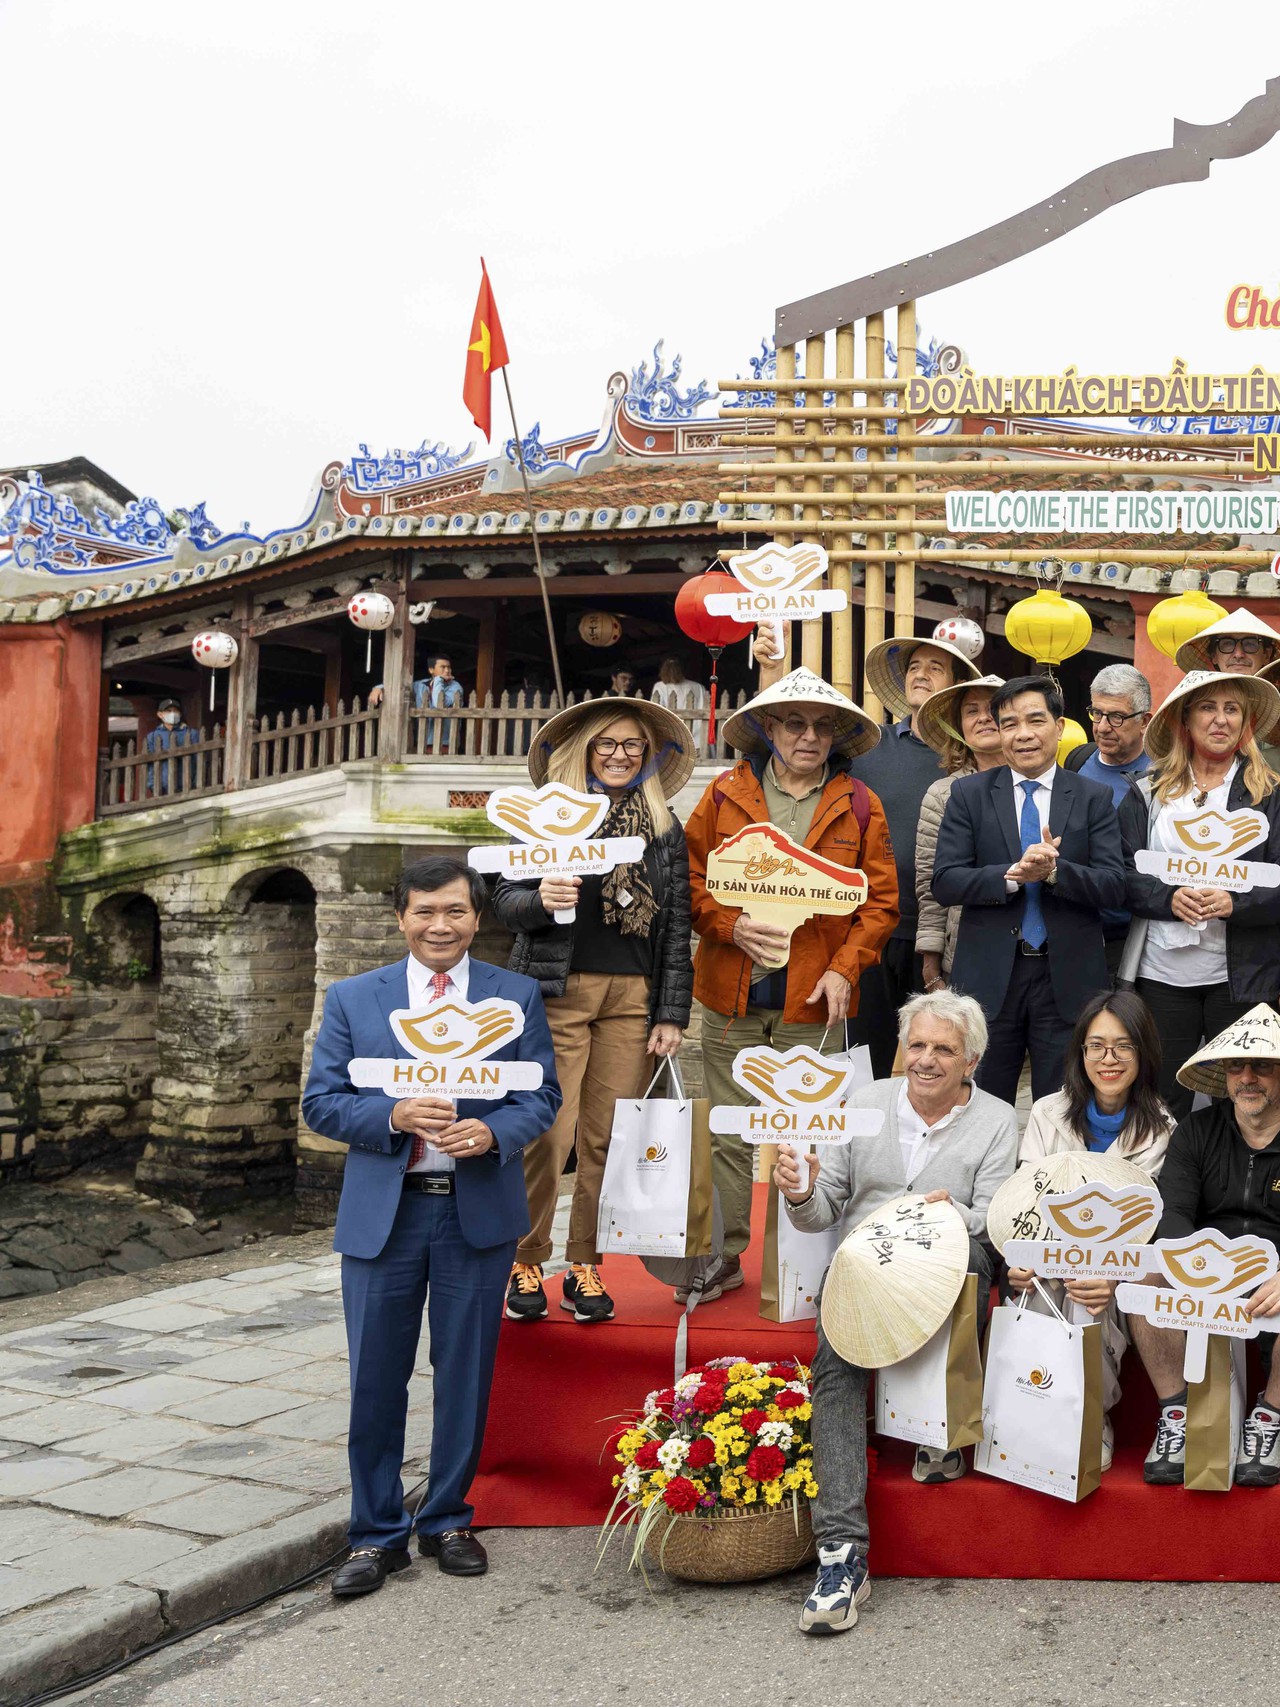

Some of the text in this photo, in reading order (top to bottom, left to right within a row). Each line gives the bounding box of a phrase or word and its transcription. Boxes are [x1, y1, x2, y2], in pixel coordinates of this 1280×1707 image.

[908, 367, 1003, 410] ĐOÀN
[1014, 367, 1128, 410] KHÁCH
[1143, 358, 1210, 409] ĐẦU
[950, 496, 1060, 528] WELCOME
[1067, 496, 1109, 528] THE
[1116, 496, 1177, 529] FIRST
[1184, 496, 1277, 529] TOURIST
[737, 593, 815, 612] HỘI AN
[509, 844, 606, 868] HỘI AN
[1167, 857, 1248, 880] HỘI AN
[708, 879, 861, 902] DI SẢN VĂN HÓA THẾ GIỚI
[393, 1061, 500, 1087] HỘI AN
[749, 1109, 845, 1133] HỘI AN
[1044, 1244, 1140, 1269] HỘI AN
[1155, 1294, 1252, 1324] HỘI AN
[1181, 1319, 1204, 1328] CRAFTS
[1205, 1322, 1217, 1330] AND
